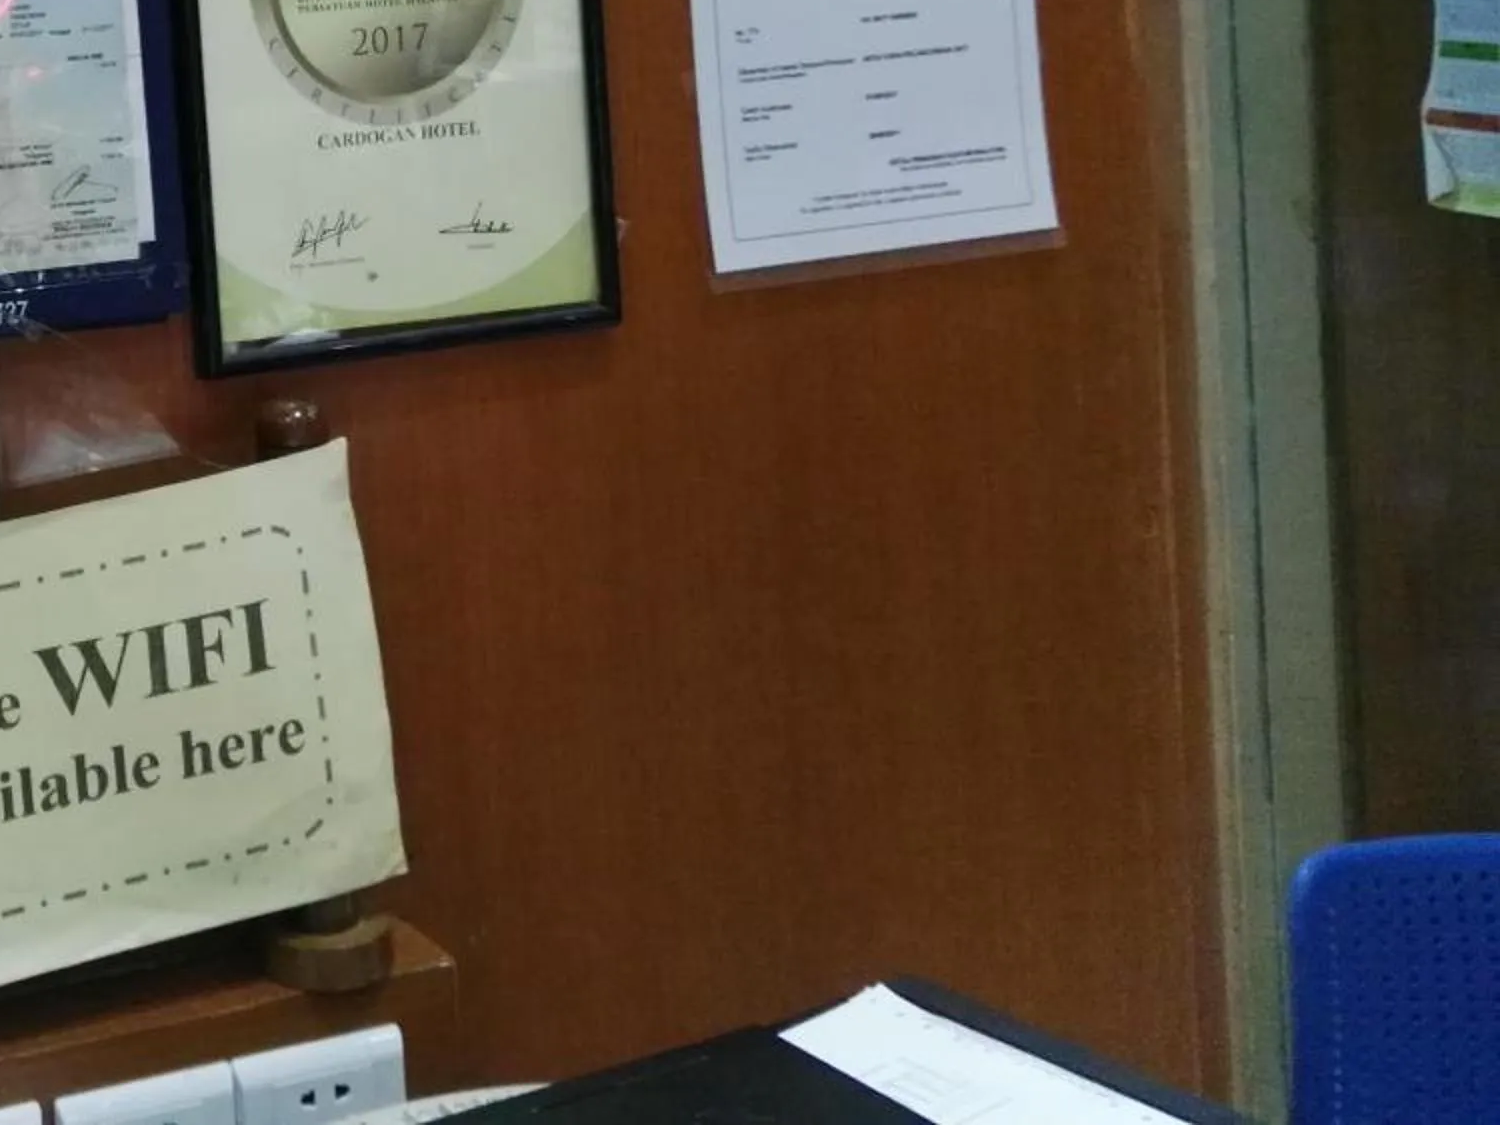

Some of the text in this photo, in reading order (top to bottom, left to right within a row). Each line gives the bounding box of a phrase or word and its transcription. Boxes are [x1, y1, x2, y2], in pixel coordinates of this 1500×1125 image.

[352, 22, 429, 57] 2017
[317, 121, 481, 151] CARDOGAN HOTEL
[33, 598, 277, 717] WIFI
[180, 716, 306, 780] here
